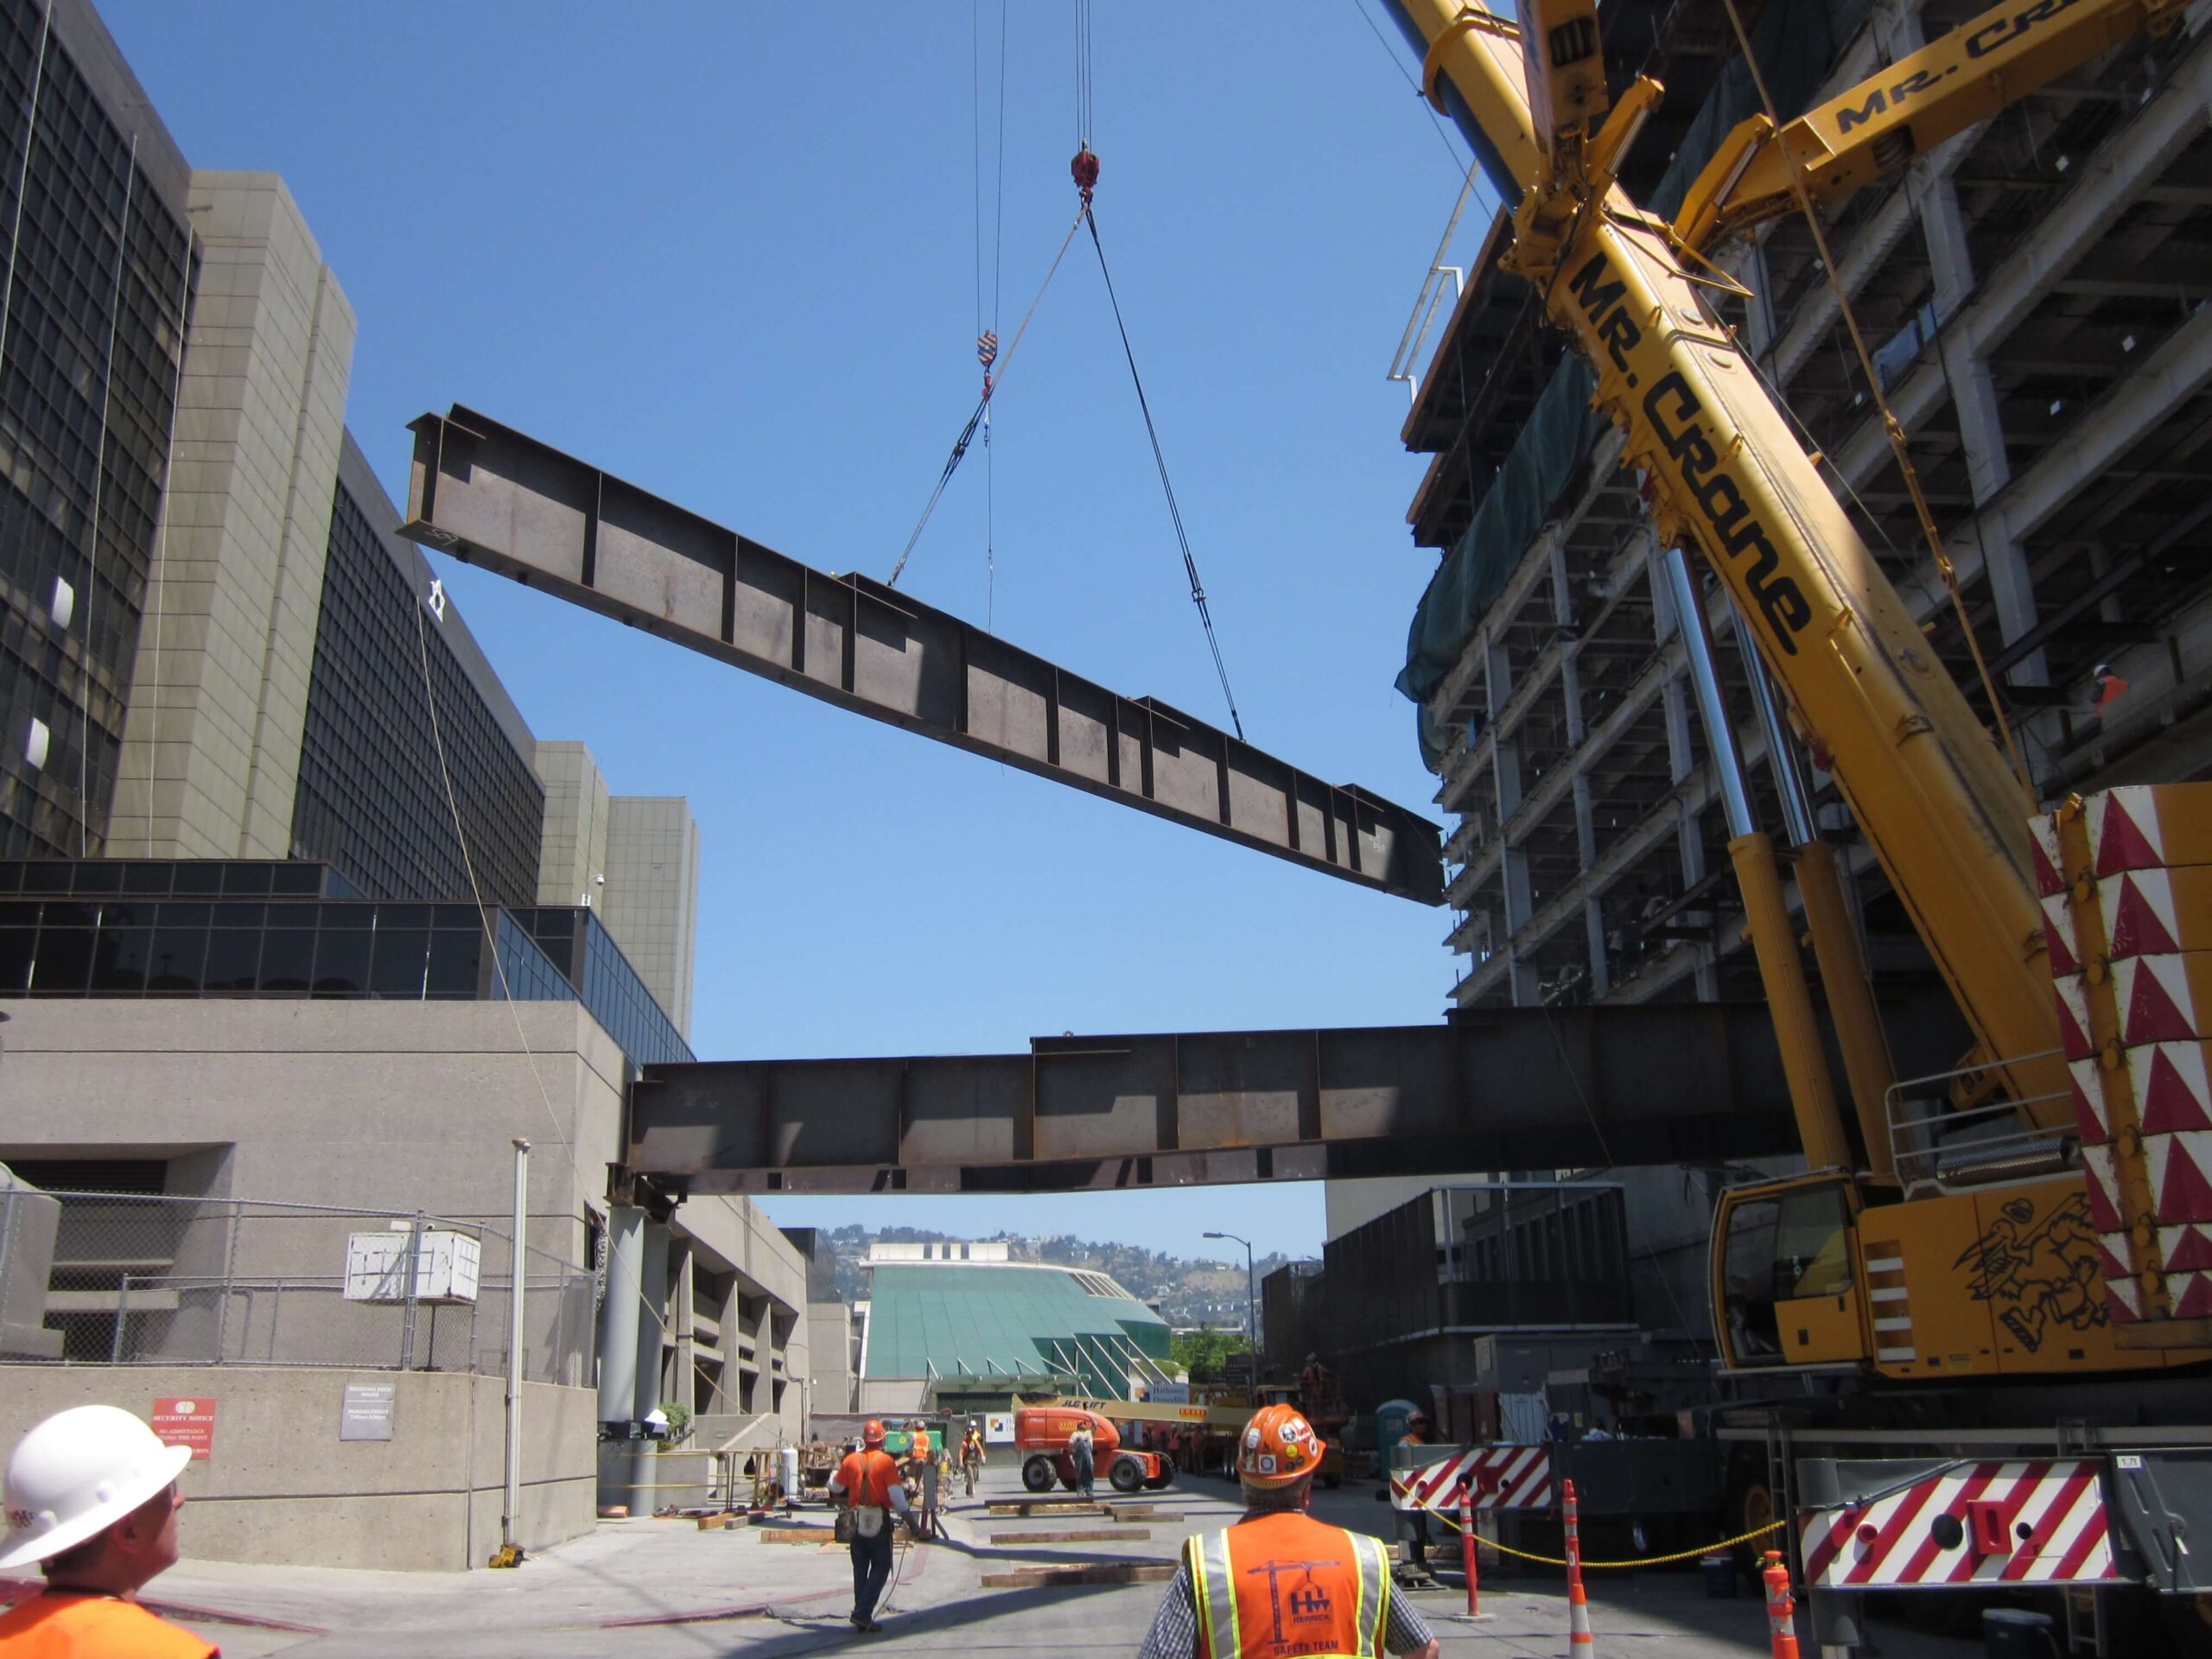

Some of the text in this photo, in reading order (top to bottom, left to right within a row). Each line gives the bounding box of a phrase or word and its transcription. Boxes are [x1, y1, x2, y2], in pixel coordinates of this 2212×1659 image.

[1293, 1615, 1330, 1624] HERRICK
[1273, 1640, 1338, 1656] SAFETY TEAM
